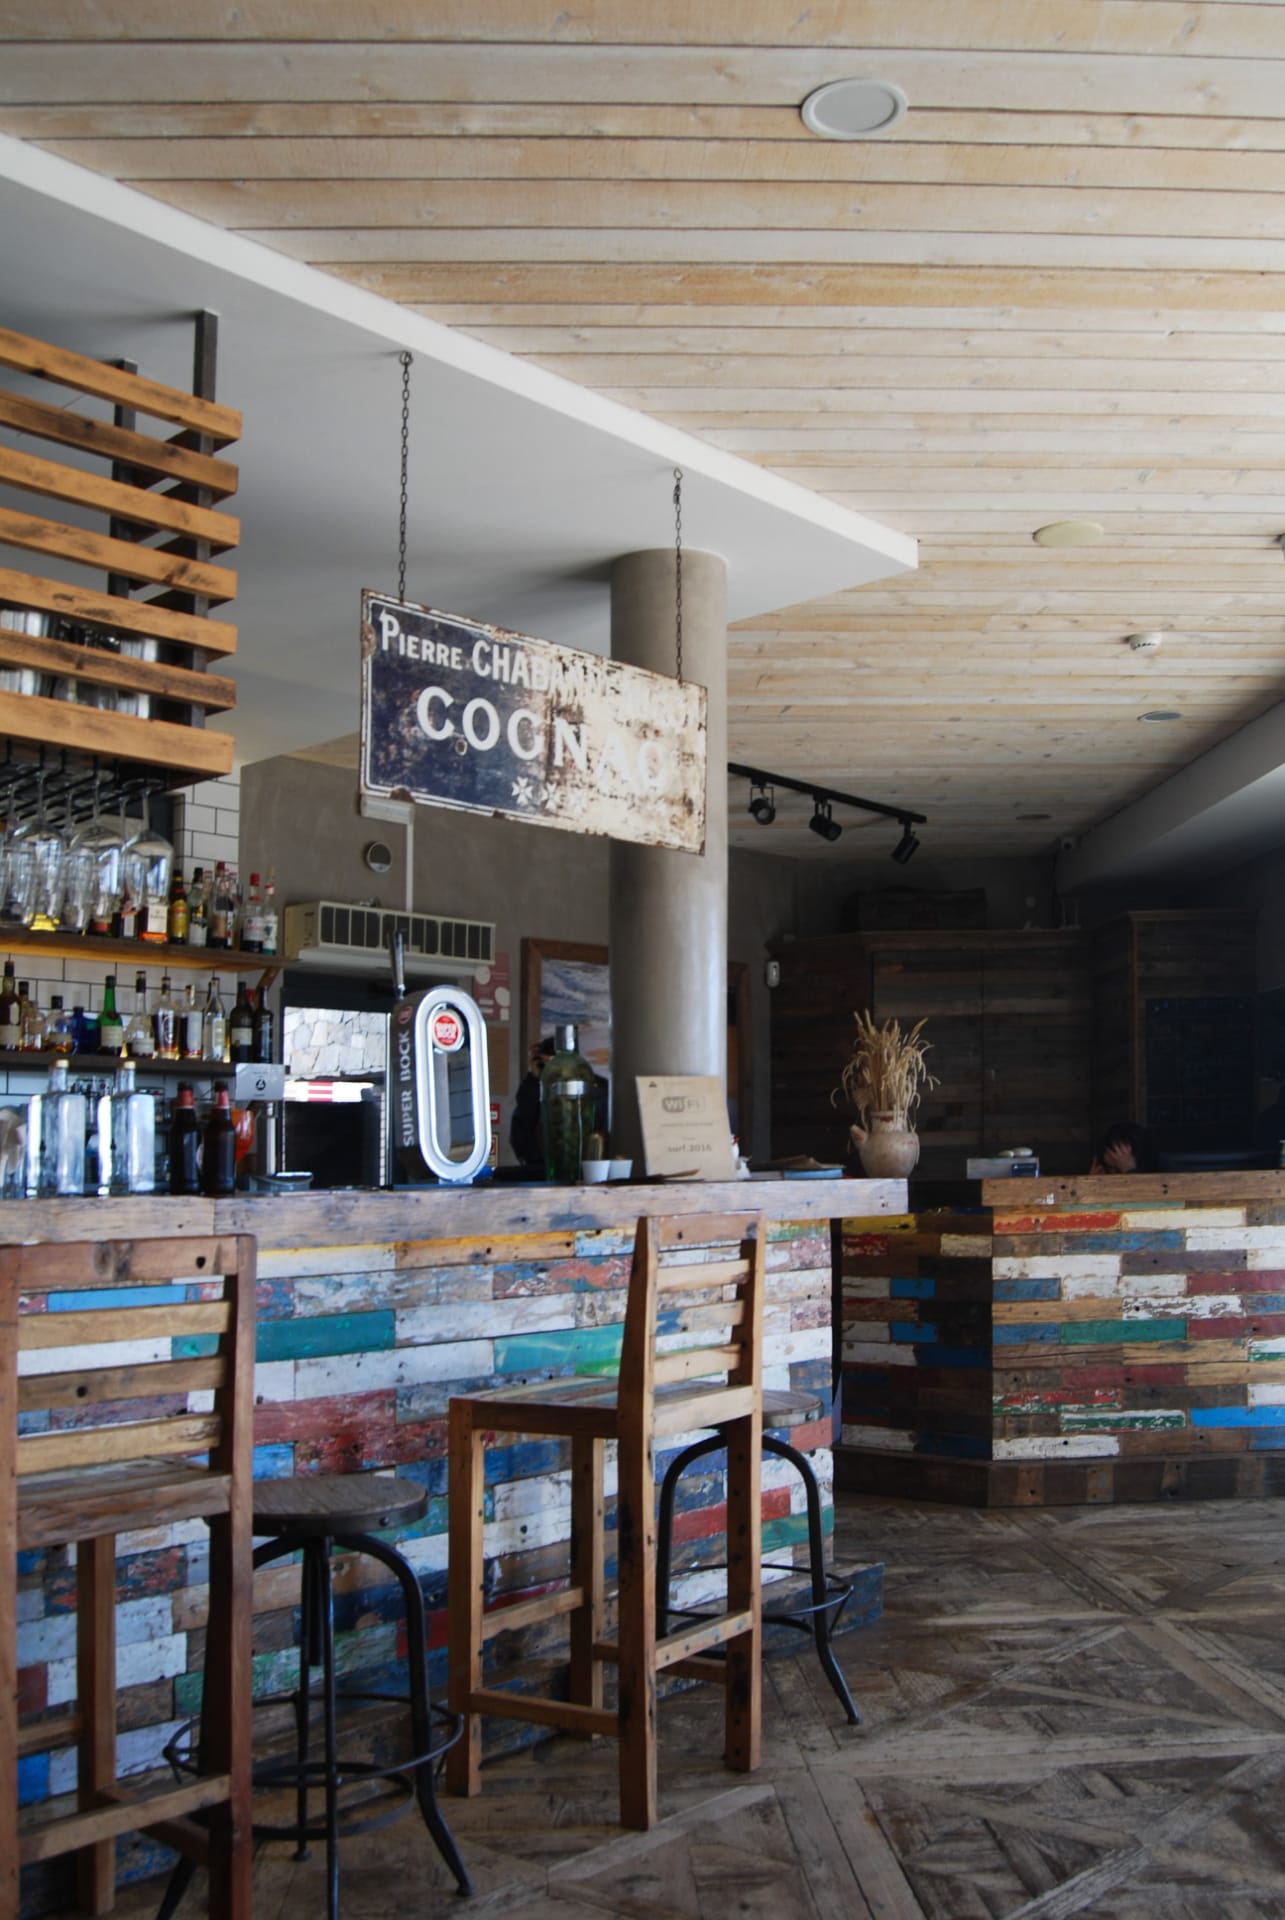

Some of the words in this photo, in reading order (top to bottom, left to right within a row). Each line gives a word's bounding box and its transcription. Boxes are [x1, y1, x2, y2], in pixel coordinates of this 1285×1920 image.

[379, 609, 463, 671] PIERRE
[416, 686, 668, 790] COGNAC
[399, 1030, 412, 1081] BOCK
[401, 1089, 414, 1146] SUPER
